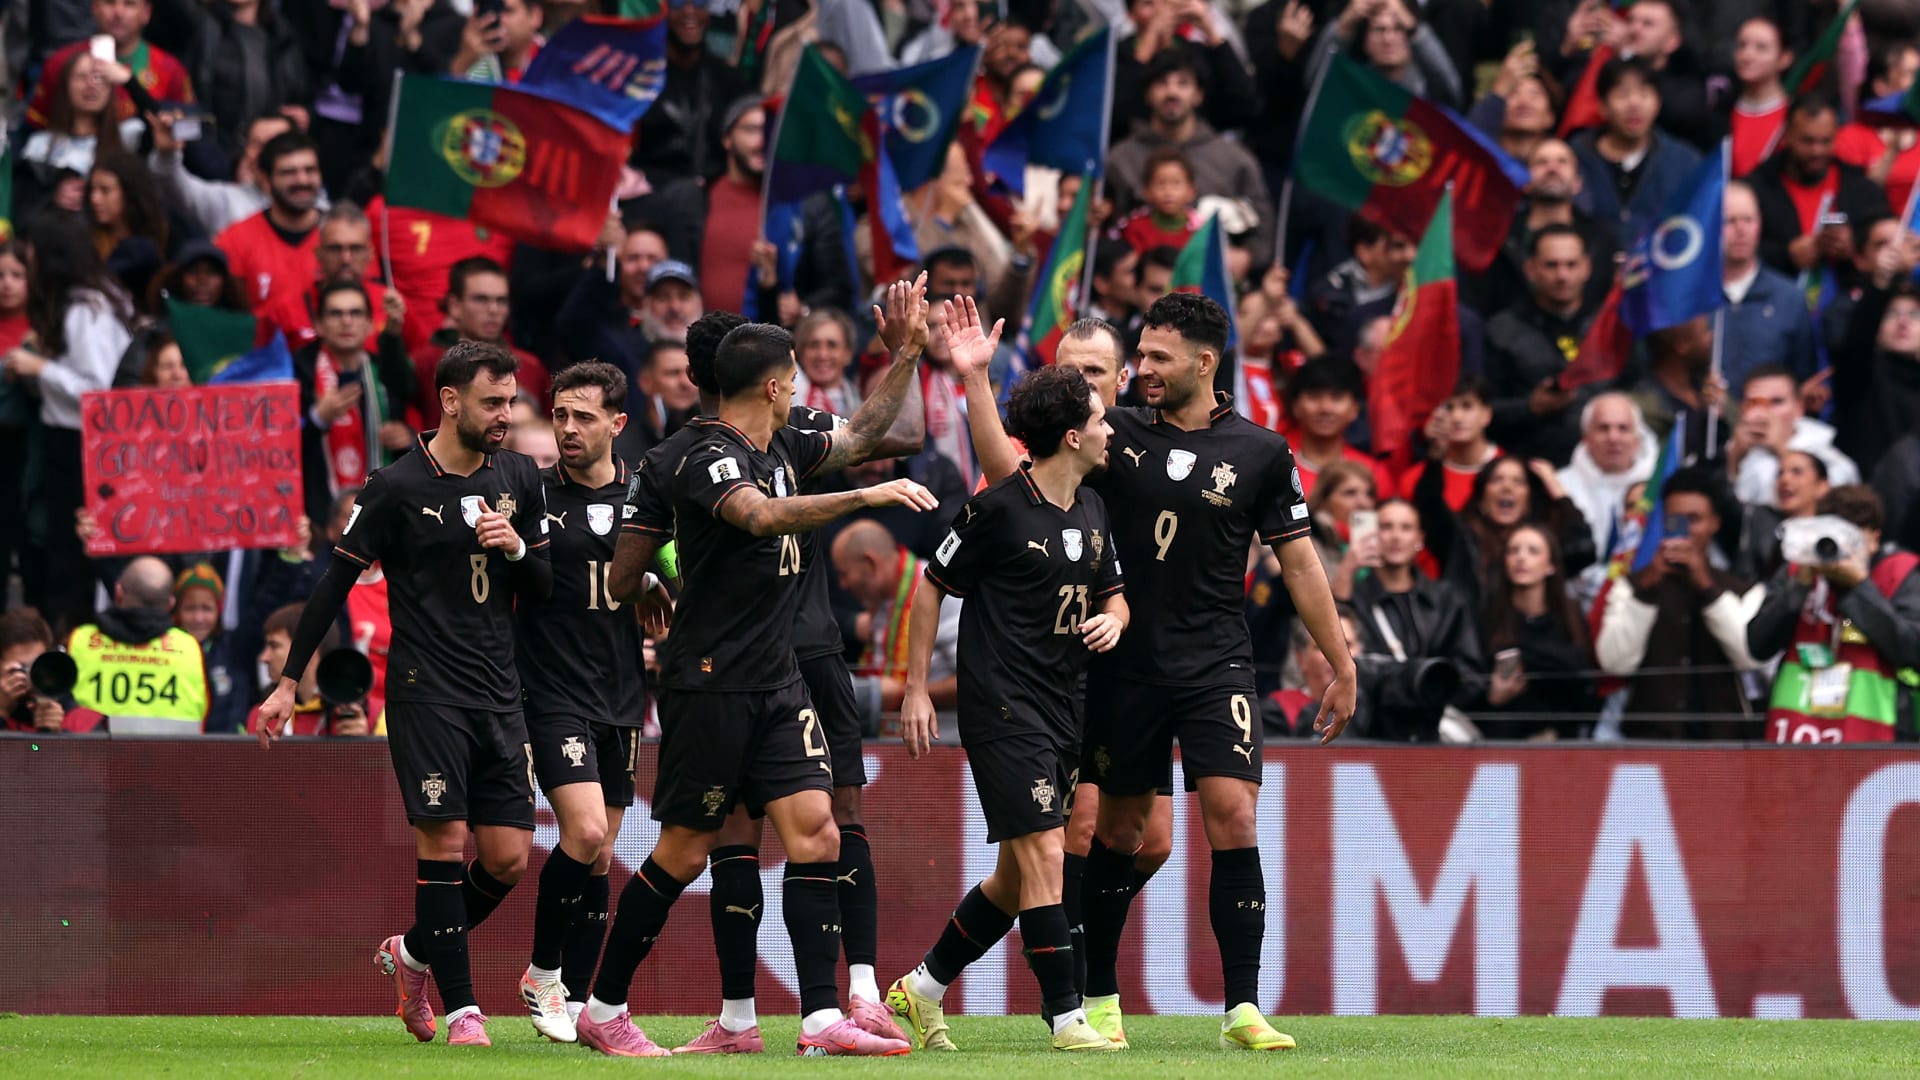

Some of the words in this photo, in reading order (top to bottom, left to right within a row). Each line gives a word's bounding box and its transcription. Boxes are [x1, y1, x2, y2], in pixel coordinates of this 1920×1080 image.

[410, 221, 431, 256] 7
[194, 395, 298, 432] NEVES
[778, 533, 801, 576] 20
[1154, 509, 1178, 562] 9
[469, 554, 490, 604] 8
[1053, 584, 1089, 635] 23
[89, 671, 179, 706] 1054
[797, 708, 831, 758] 2
[1230, 694, 1252, 743] 9
